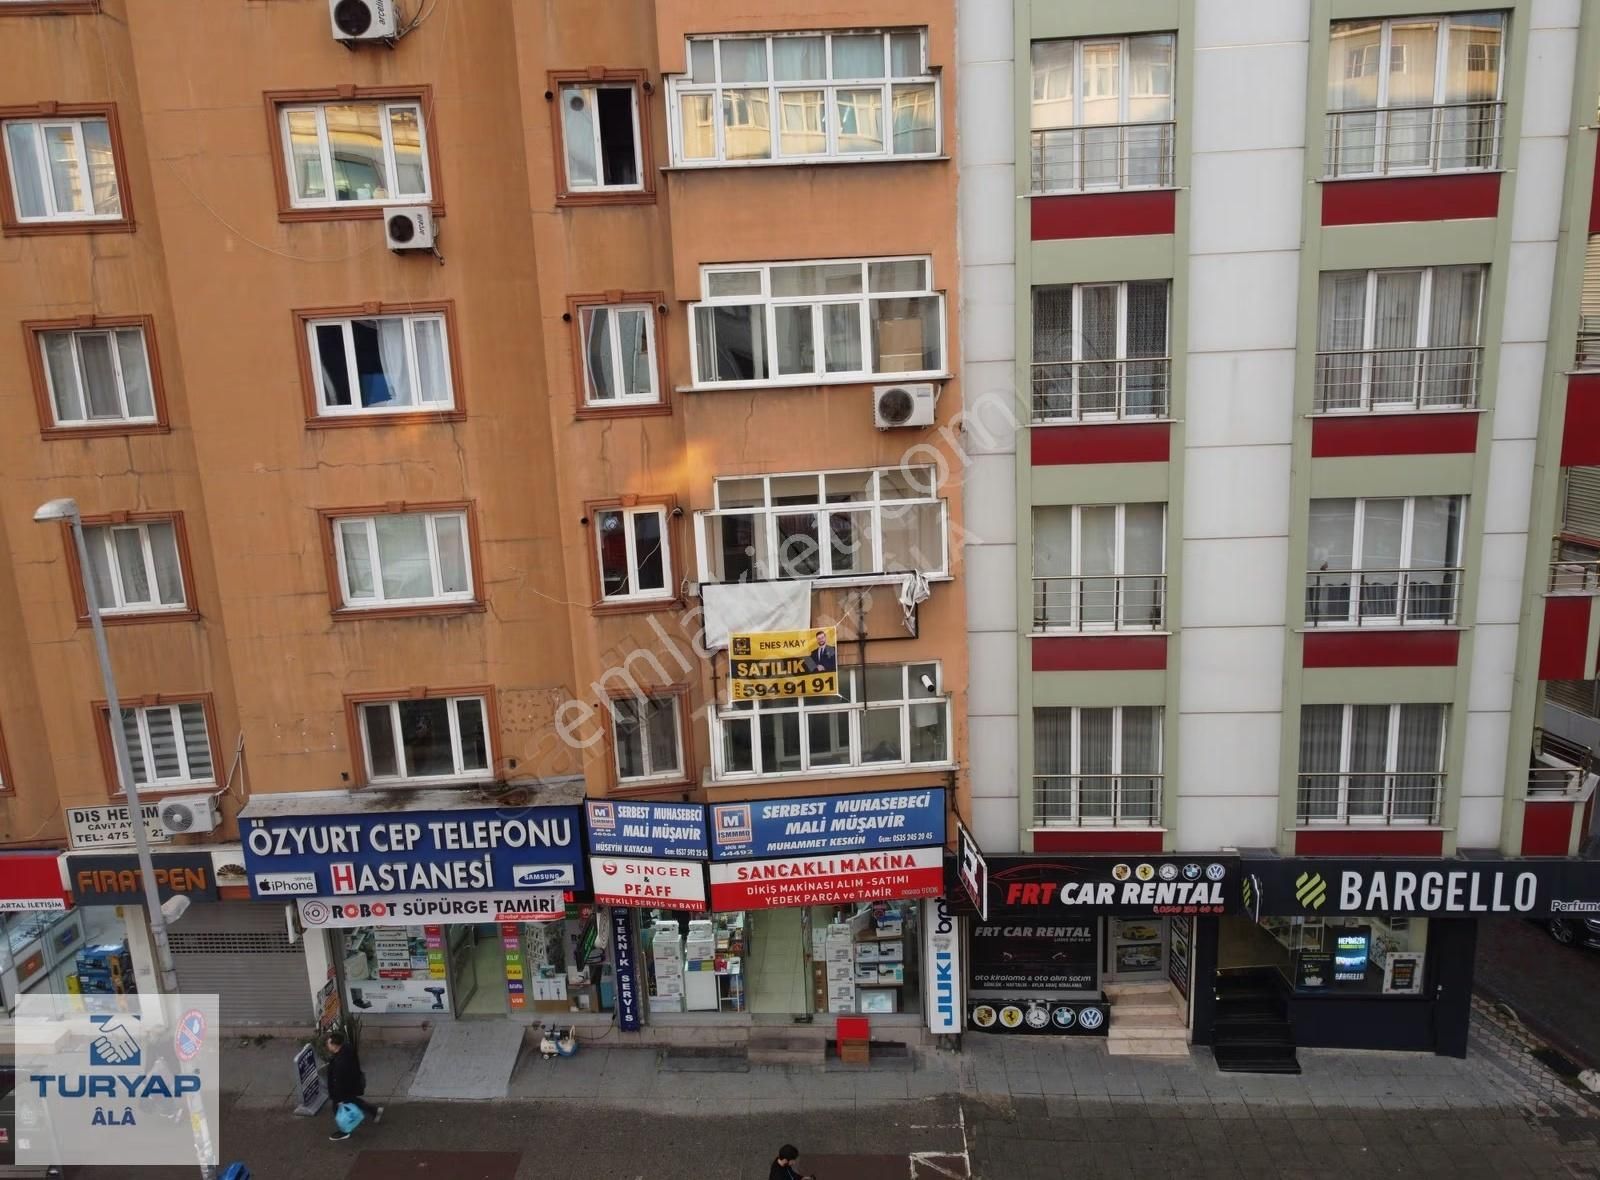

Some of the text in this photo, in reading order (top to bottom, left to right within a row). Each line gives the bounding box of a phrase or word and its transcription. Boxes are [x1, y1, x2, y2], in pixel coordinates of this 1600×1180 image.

[759, 639, 806, 650] ENES AKAY
[737, 659, 806, 677] SATILIK
[743, 682, 780, 697] 594
[783, 680, 807, 695] 91
[812, 676, 835, 693] 91
[617, 806, 703, 821] SERBEST MUHASEBECİ
[762, 791, 931, 819] SERBEST MUHASEBECİ
[723, 815, 739, 828] M
[785, 812, 905, 835] MALİ MÜŞAVİR
[76, 833, 104, 843] TEL:
[107, 832, 129, 840] 475
[249, 818, 571, 857] ÖZYURT CEP TELEFONU
[623, 823, 701, 842] MALİ MÜŞAVİR
[595, 842, 622, 853] HÜSEYİN
[624, 845, 653, 854] KAYACAN
[766, 839, 828, 851] MUHAMMET
[829, 834, 865, 846] KESKİN
[331, 853, 494, 893] HASTANESİ
[625, 864, 690, 877] SINGER
[737, 852, 917, 880] SANCAKLI MAKİNA
[271, 880, 314, 891] iPhone
[523, 872, 561, 881] SAMSUNG
[624, 884, 671, 897] PFAFF
[747, 884, 777, 896] DİKİŞ
[779, 881, 834, 893] MAKİNASI
[837, 878, 863, 889] ALIM
[765, 895, 801, 905] YEDEK
[804, 893, 840, 902] PARÇA
[859, 887, 892, 898] TAMİR
[1006, 882, 1225, 905] FRT CAR RENTAL
[1339, 871, 1538, 912] BARGELLO
[332, 895, 555, 919] ROBOT SÜPÜRGE TAMİRİ
[600, 896, 633, 906] YETKİLİ
[634, 899, 665, 908] SERVİS
[975, 926, 1091, 937] FRT CAR RENTAL
[936, 952, 953, 1026] JUKI
